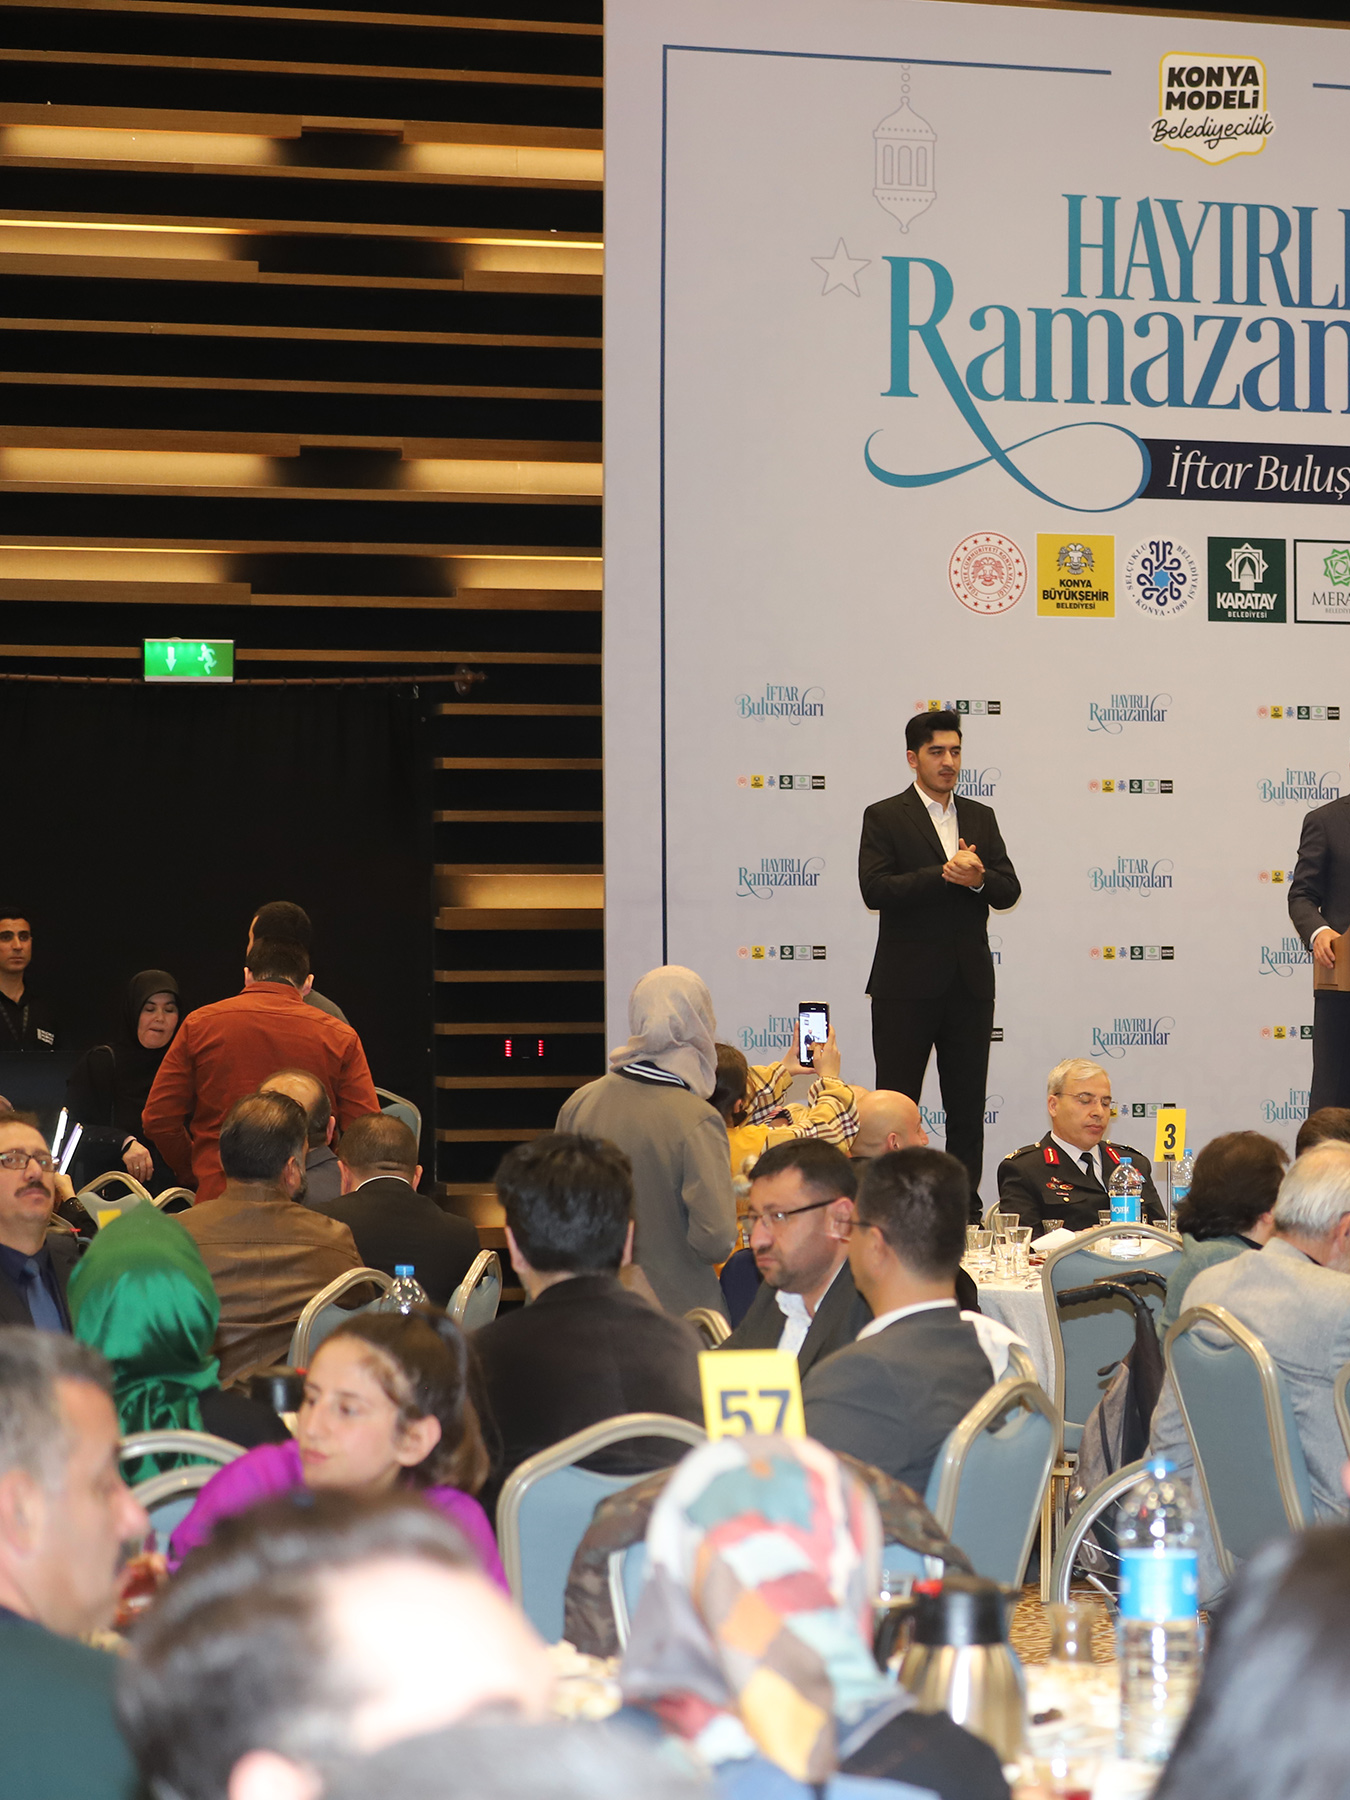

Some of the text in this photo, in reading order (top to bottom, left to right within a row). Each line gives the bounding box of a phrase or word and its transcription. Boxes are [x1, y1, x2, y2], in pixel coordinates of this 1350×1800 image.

[1167, 66, 1260, 88] KONYA
[1151, 113, 1274, 150] Belediyecilik
[1168, 444, 1254, 493] İftar
[1124, 543, 1200, 600] SELÇUKLU BELEDİYESİ
[1059, 579, 1092, 588] KONYA
[1042, 587, 1109, 602] BÜYÜKŞEHİR
[1216, 592, 1277, 610] KARATAY
[1056, 602, 1096, 610] BELEDİYESİ
[1135, 598, 1188, 616] KONYA 1989
[1227, 611, 1267, 619] BELEDİYESİ
[766, 683, 799, 701] İFTAR
[1111, 694, 1149, 708] HAYIRLI
[1087, 693, 1173, 735] Ramazanlar
[1286, 768, 1317, 786] İFTAR
[761, 858, 800, 873] HAYIRLI
[1118, 855, 1149, 874] İFTAR
[736, 856, 825, 900] Ramazanlar
[1114, 1018, 1152, 1032] HAYIRLI
[1090, 1015, 1175, 1059] Ramazanlar
[1163, 1123, 1176, 1150] 3
[720, 1389, 790, 1437] 57
